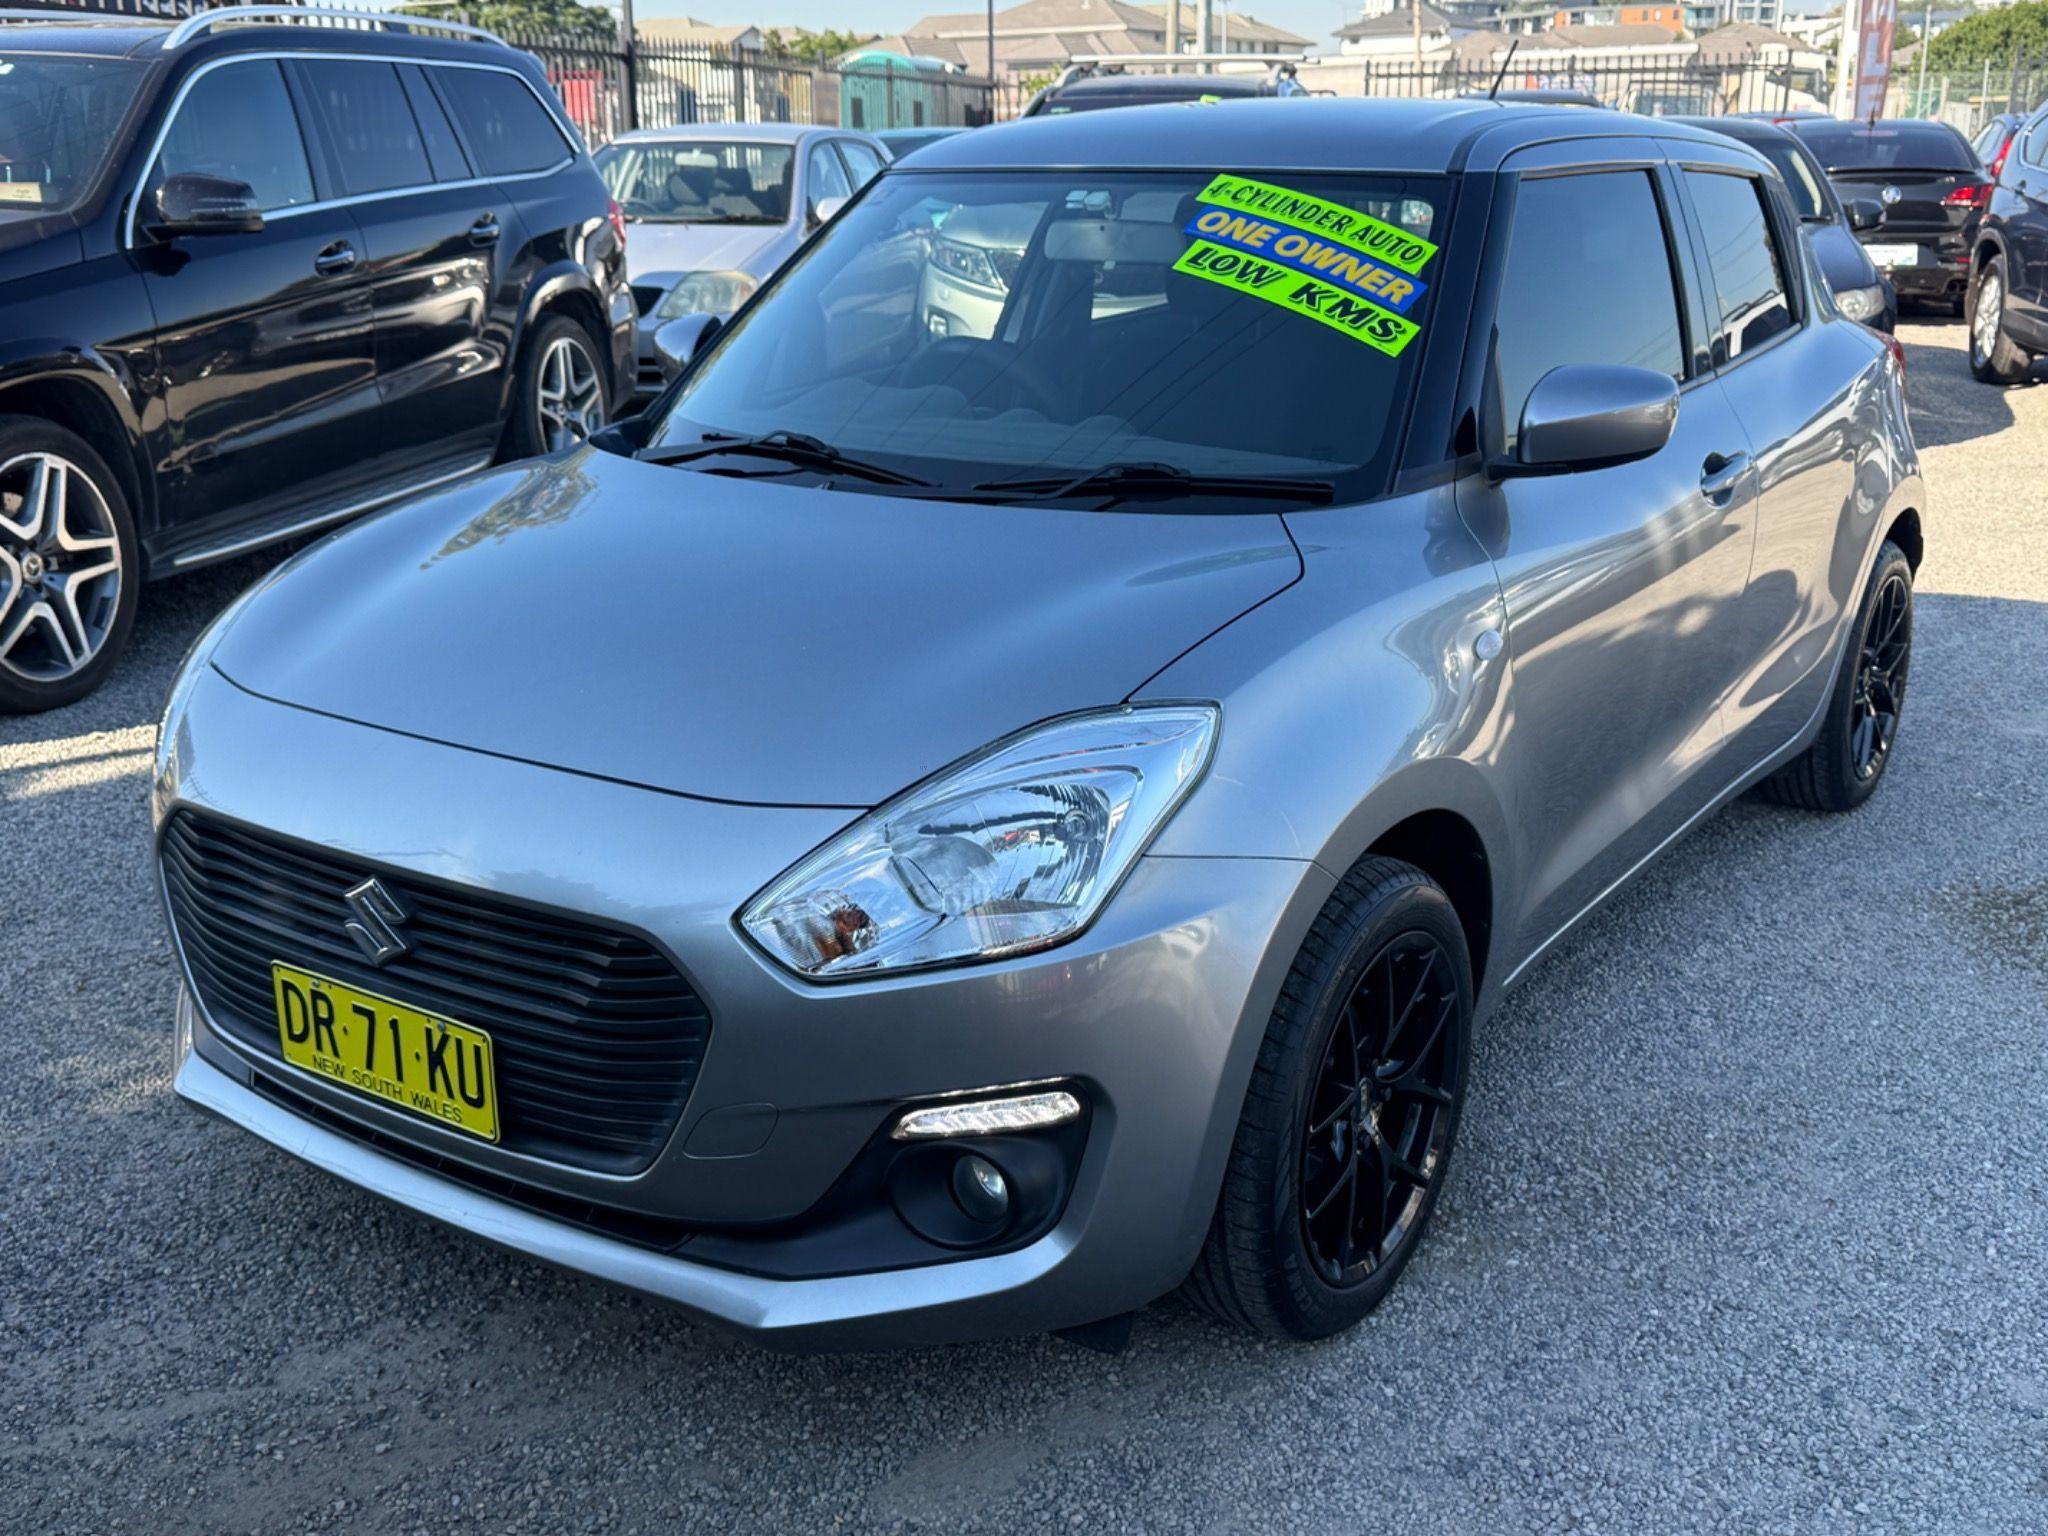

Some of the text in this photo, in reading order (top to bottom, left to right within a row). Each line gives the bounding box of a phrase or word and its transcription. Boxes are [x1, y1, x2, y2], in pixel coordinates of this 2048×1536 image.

[1197, 211, 1414, 304] ONE OWNER
[1208, 181, 1425, 264] 4-CYLINDER AUTO
[1185, 247, 1407, 342] LOW KMS
[312, 1055, 464, 1123] NEW SOUTH WALES
